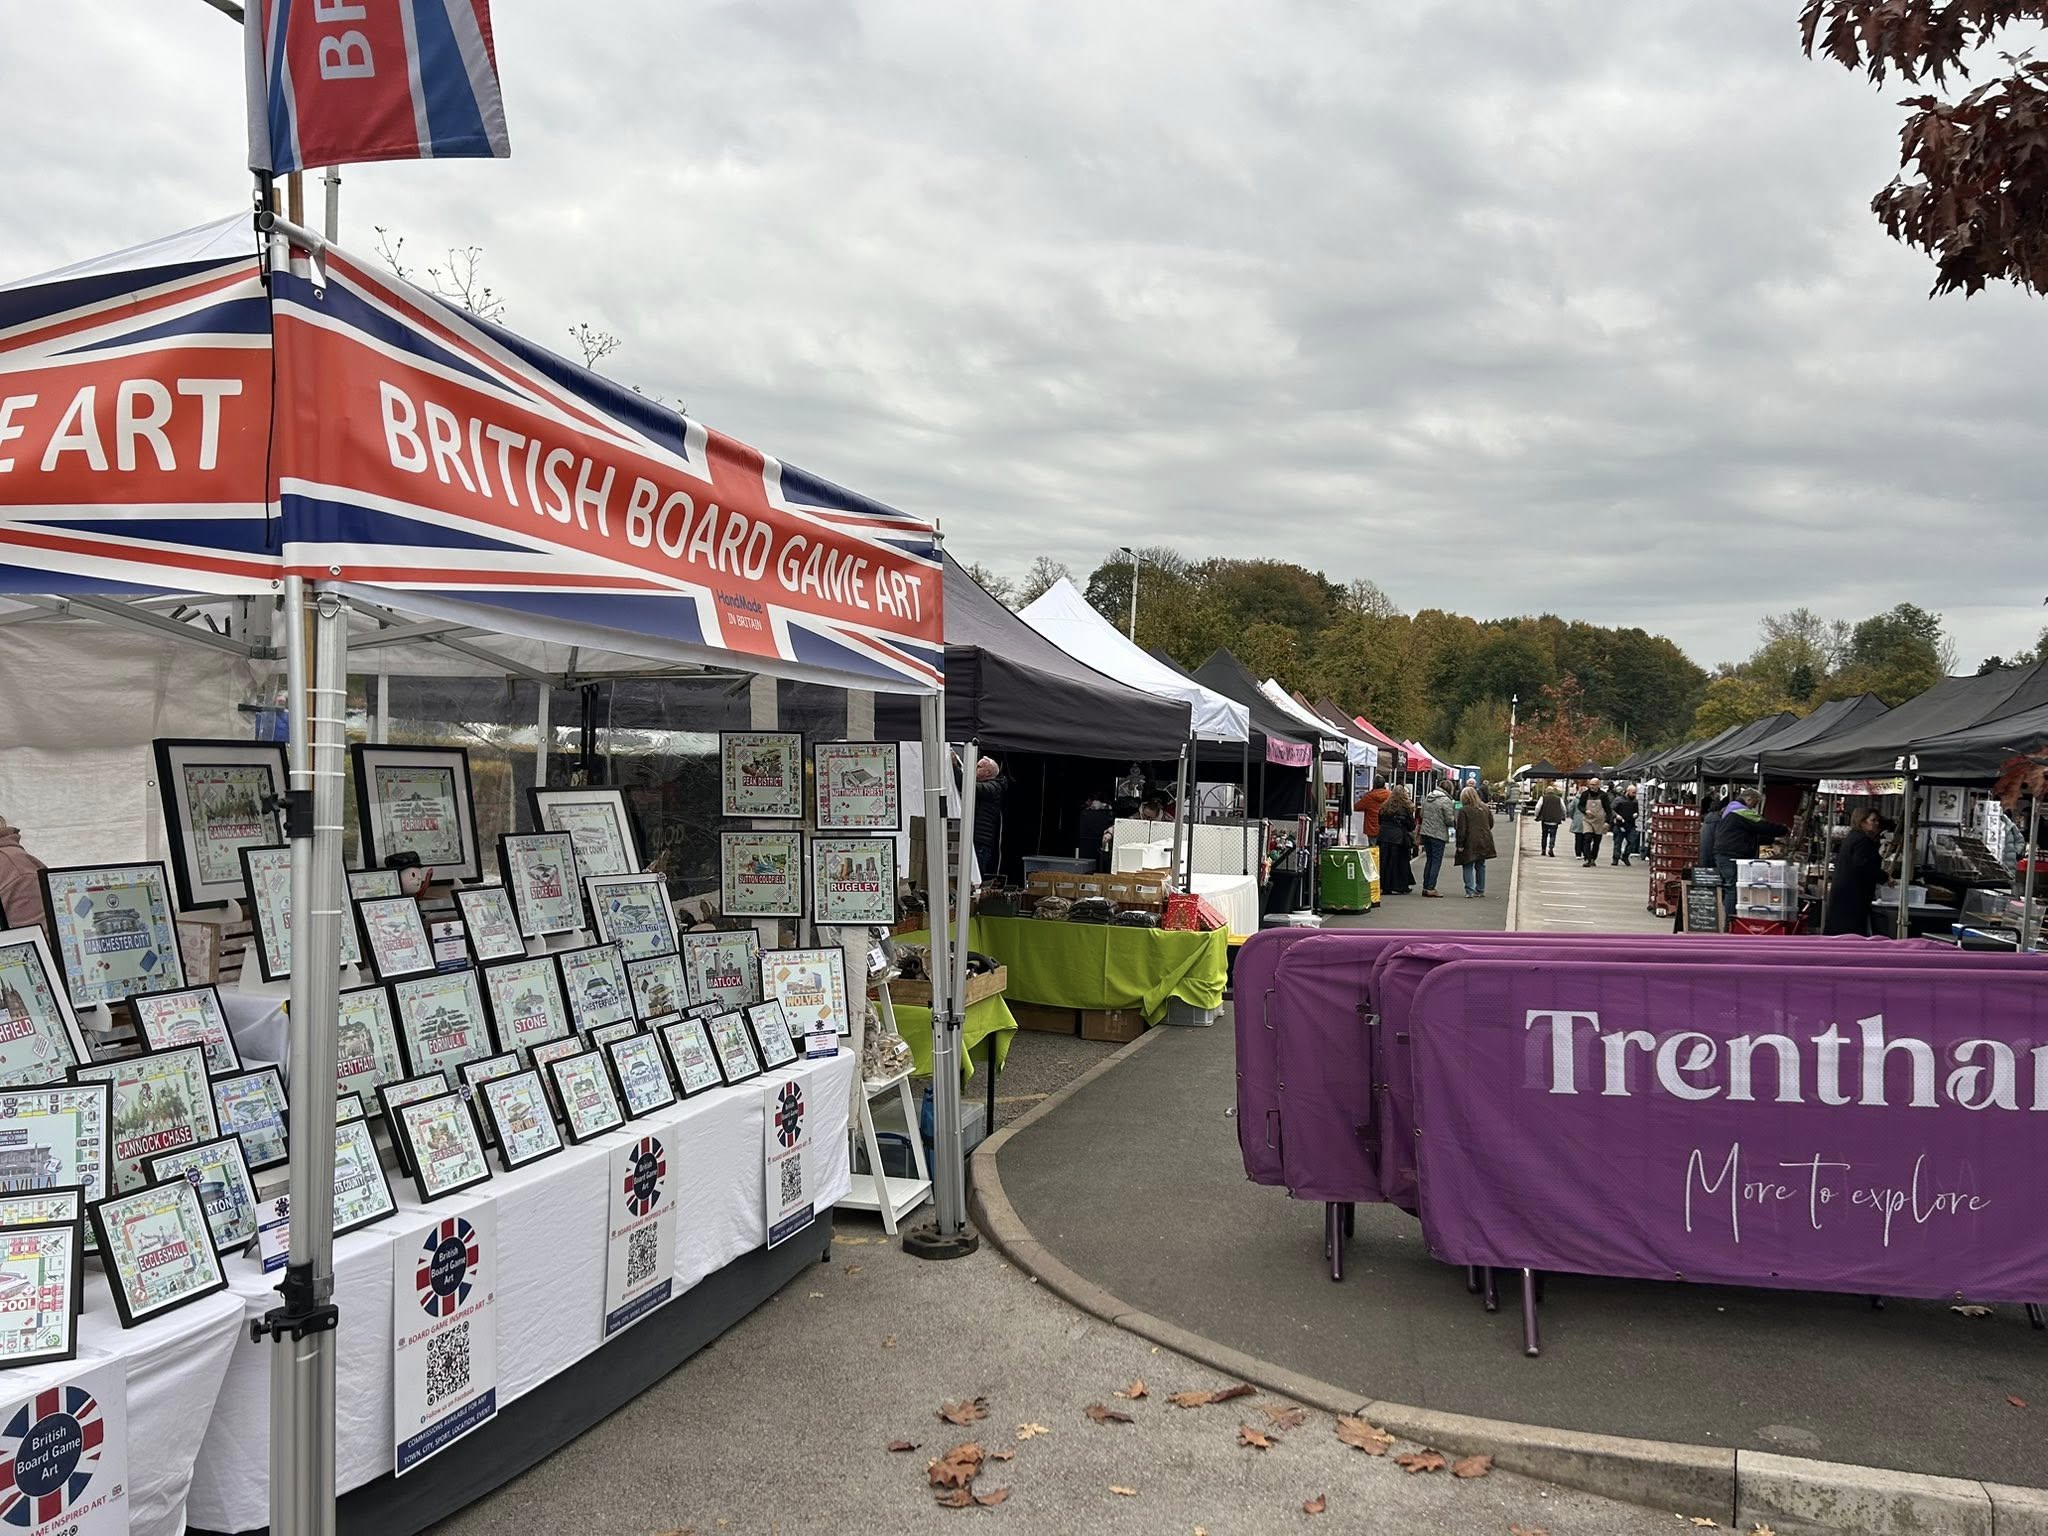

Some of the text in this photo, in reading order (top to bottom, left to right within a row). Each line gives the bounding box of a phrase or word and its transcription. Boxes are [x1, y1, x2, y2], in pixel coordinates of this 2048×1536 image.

[41, 378, 243, 472] ART
[379, 379, 922, 623] BRITISH BOARD GAME ART
[716, 590, 764, 615] HandMade
[728, 612, 763, 632] IN BRITAIN
[743, 776, 783, 787] PEAK DISTRICT
[864, 788, 884, 797] FOREST
[209, 824, 262, 840] CANNOCK CHASE
[401, 818, 433, 832] FORMULA
[588, 845, 609, 855] COUNTY
[738, 874, 786, 884] SUTTON COLDFIELD
[830, 882, 878, 892] RUGELEY
[530, 884, 562, 899] STOKE CITY
[647, 923, 659, 932] CITY
[84, 934, 150, 955] MANCHESTER CITY
[384, 939, 401, 952] STOKE
[708, 976, 741, 988] MATLOCK
[581, 996, 620, 1012] CHESTERFIELD
[785, 995, 823, 1006] WOLVES
[514, 1014, 547, 1033] STONE
[428, 1032, 467, 1054] FORMULA 1
[337, 1055, 376, 1078] RENTHAM
[117, 1125, 192, 1160] CANNOCK CHASE
[430, 1149, 443, 1162] PEAK
[334, 1174, 366, 1194] TTS COUNTY
[1685, 1142, 1797, 1243] More
[1851, 1153, 1992, 1247] explore
[207, 1198, 233, 1216] RTON
[138, 1242, 189, 1271] ECCLESHALL
[438, 1246, 459, 1262] British
[431, 1256, 466, 1278] Board Game
[444, 1273, 454, 1285] Art
[0, 1297, 36, 1312] POOL
[408, 1300, 485, 1345] BOARD GAME INSPIRED ART
[407, 1394, 487, 1449] COMMISSIONS AVAILABLE FOR ANY
[32, 1425, 66, 1451] British
[17, 1437, 81, 1475] Board Game
[404, 1449, 422, 1465] TOWN,
[422, 1441, 435, 1456] CITY,
[41, 1464, 59, 1480] Art
[51, 1504, 90, 1531] INSPIRED
[90, 1494, 107, 1512] ART
